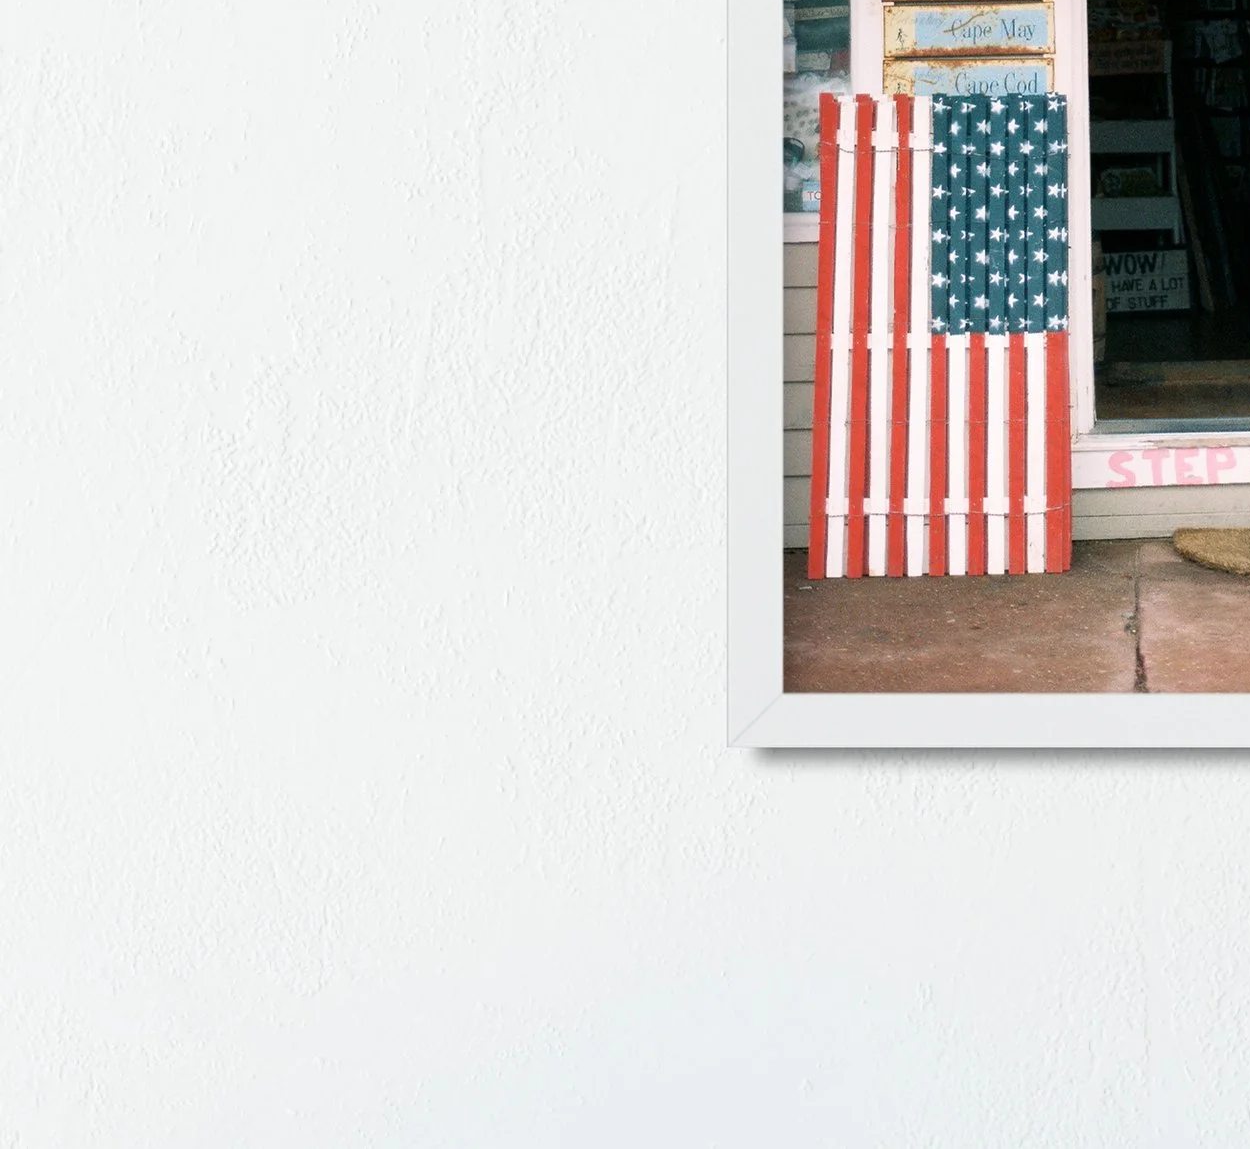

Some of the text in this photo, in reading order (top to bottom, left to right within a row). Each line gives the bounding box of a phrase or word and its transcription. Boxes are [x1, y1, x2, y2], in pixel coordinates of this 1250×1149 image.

[950, 14, 992, 44] Cape
[1000, 18, 1036, 41] May
[1003, 69, 1039, 94] Cod
[1111, 276, 1184, 293] HAVE A LOT
[1107, 446, 1238, 488] STEP
